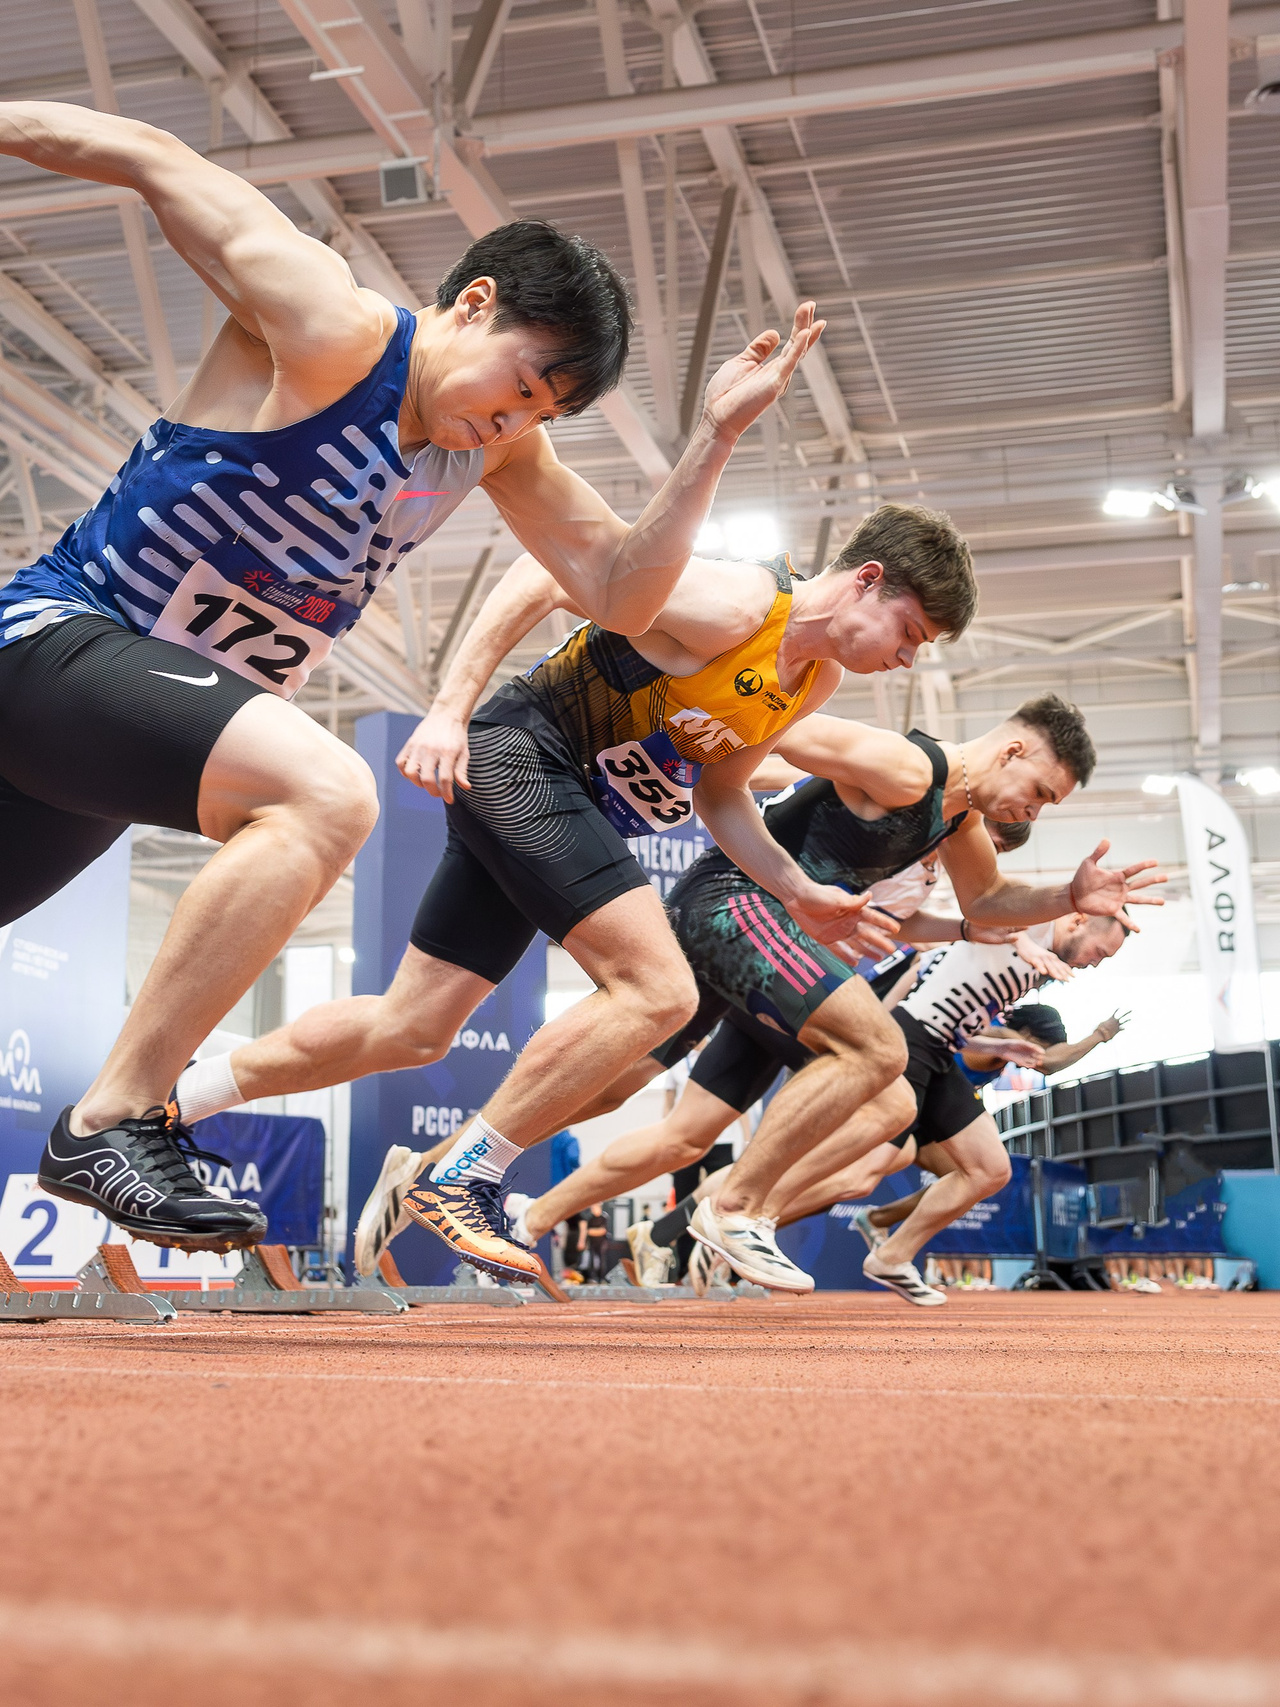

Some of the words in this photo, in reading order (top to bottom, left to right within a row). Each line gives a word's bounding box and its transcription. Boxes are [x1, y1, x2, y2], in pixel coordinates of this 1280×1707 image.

[185, 593, 311, 685] 172
[294, 596, 336, 623] 2026
[605, 749, 691, 824] 353
[189, 1158, 262, 1193] ФЛА
[13, 1199, 58, 1265] 2
